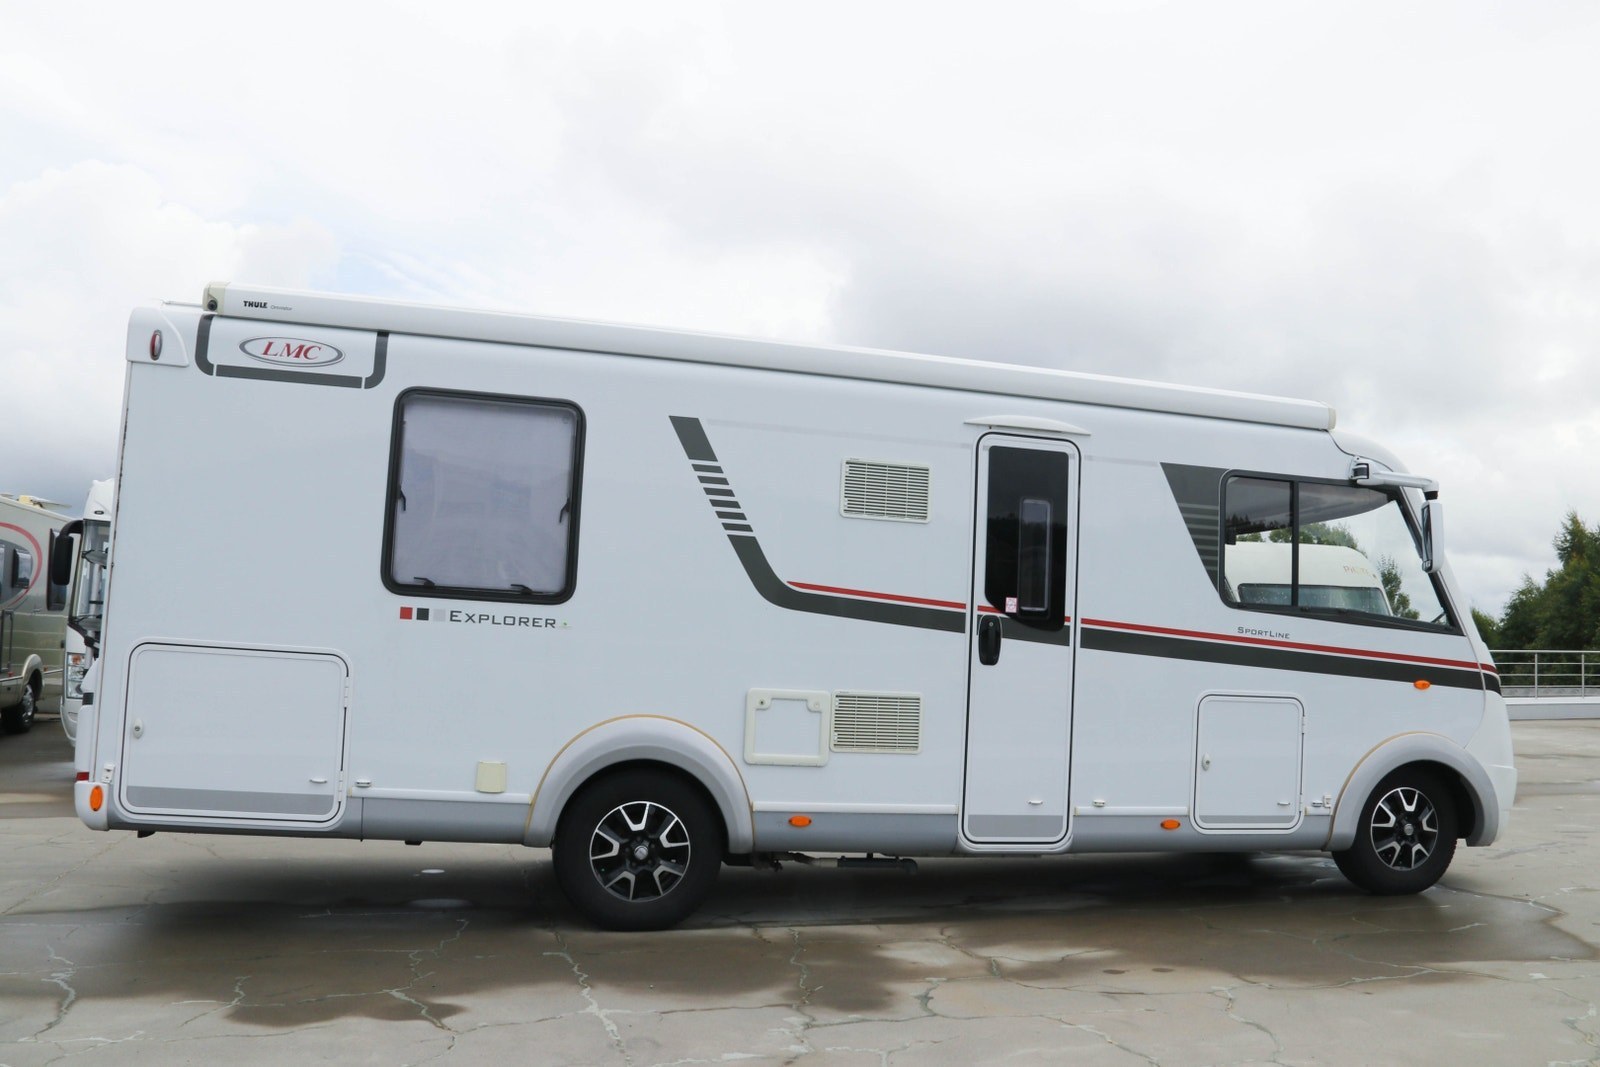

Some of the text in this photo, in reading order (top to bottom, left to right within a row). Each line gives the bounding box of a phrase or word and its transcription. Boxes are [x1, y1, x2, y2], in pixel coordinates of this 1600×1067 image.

[243, 300, 268, 309] THULE
[262, 341, 322, 360] LMC
[450, 610, 556, 628] EXPLORER
